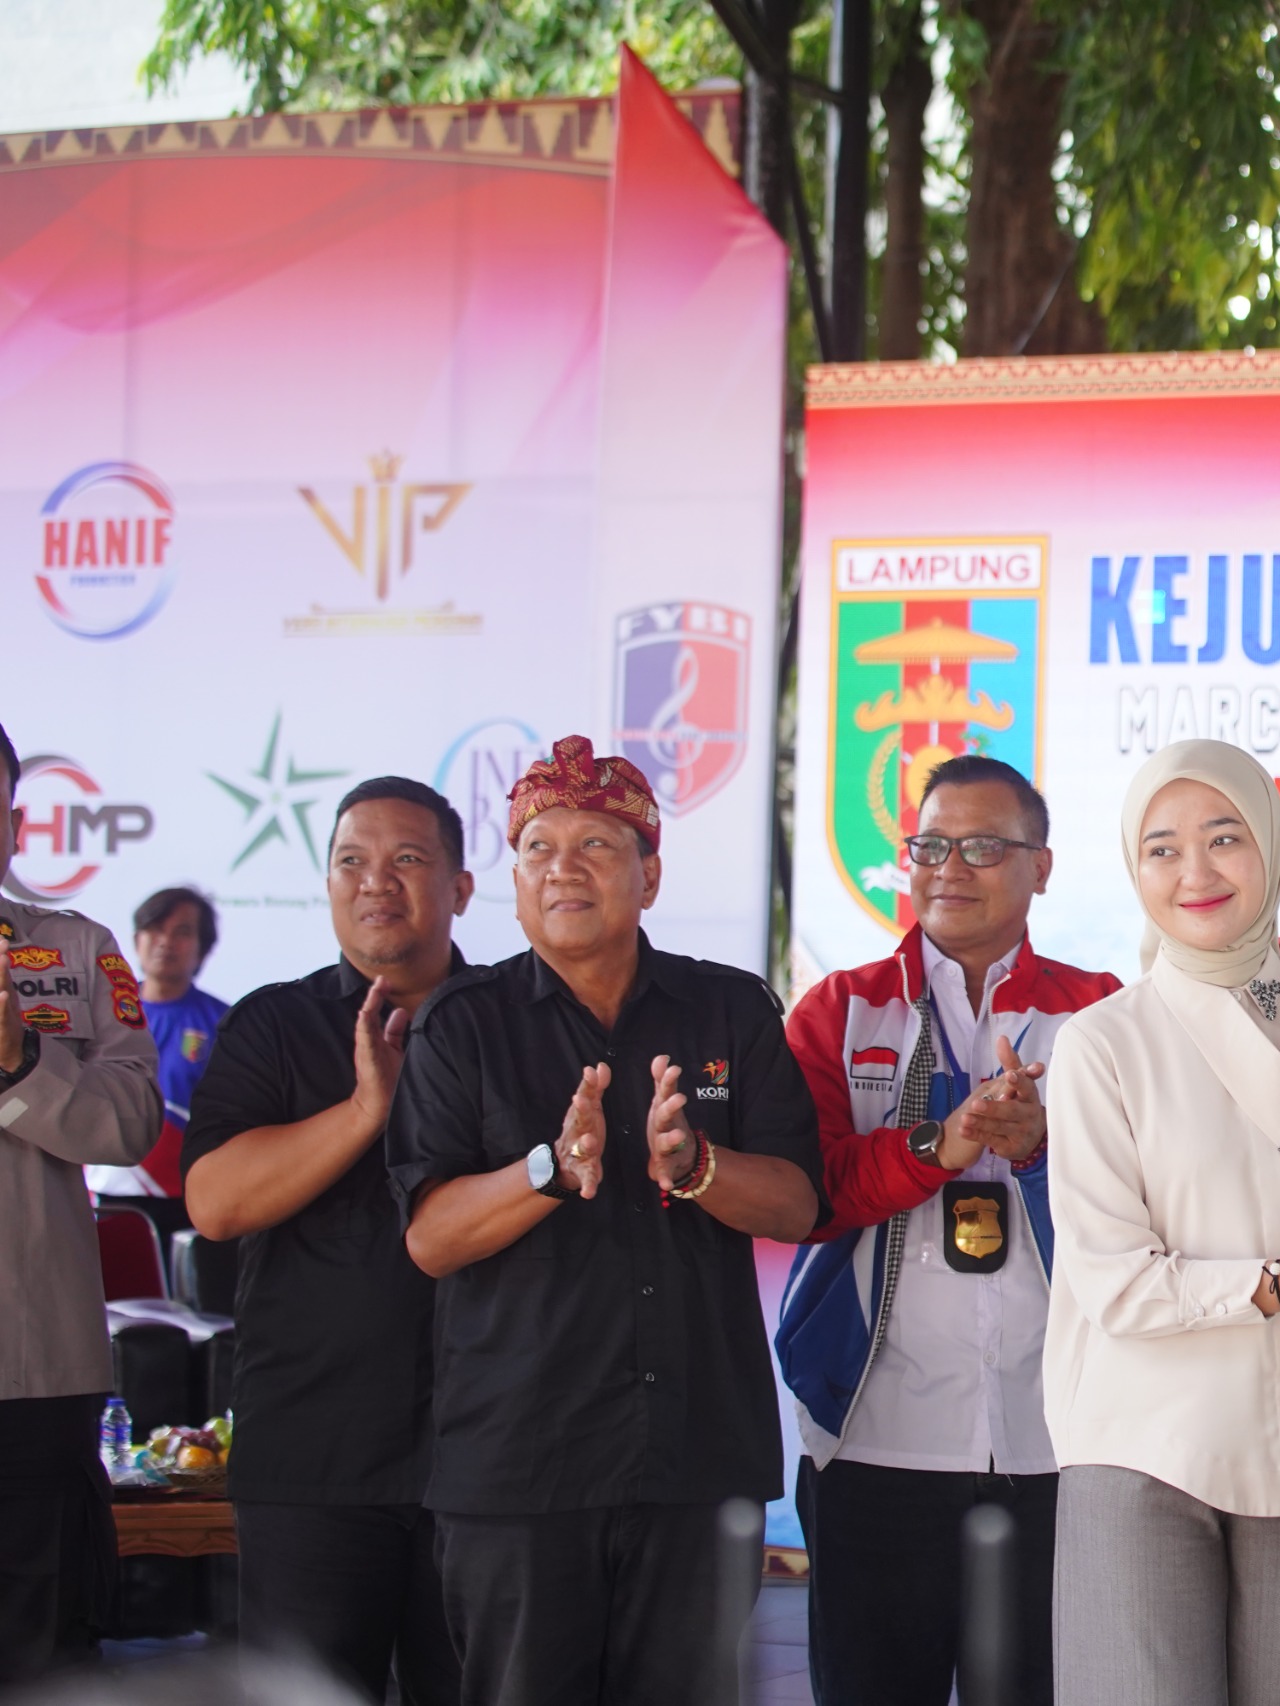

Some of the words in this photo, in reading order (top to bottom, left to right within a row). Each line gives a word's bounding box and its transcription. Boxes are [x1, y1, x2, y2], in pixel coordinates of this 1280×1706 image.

[44, 517, 172, 567] HANIF
[297, 482, 474, 602] VIP
[848, 553, 1032, 585] LAMPUNG
[619, 605, 747, 642] FYBI
[16, 804, 154, 855] HMP
